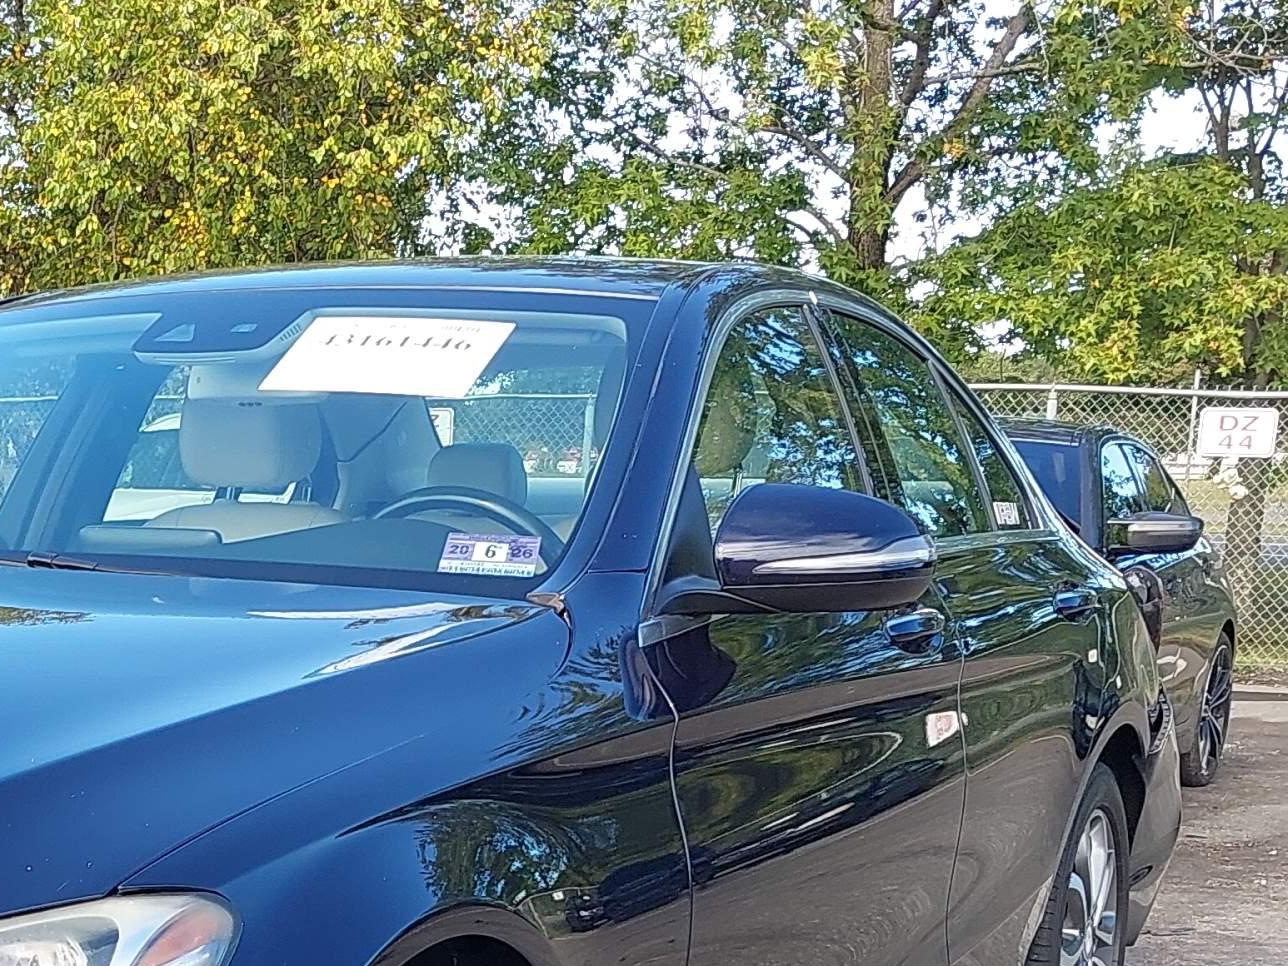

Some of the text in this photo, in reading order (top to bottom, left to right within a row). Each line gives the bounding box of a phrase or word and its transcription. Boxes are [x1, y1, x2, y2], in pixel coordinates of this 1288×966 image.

[1219, 415, 1259, 431] DZ
[1218, 434, 1253, 450] 44
[448, 544, 470, 555] 20
[485, 544, 497, 559] 6
